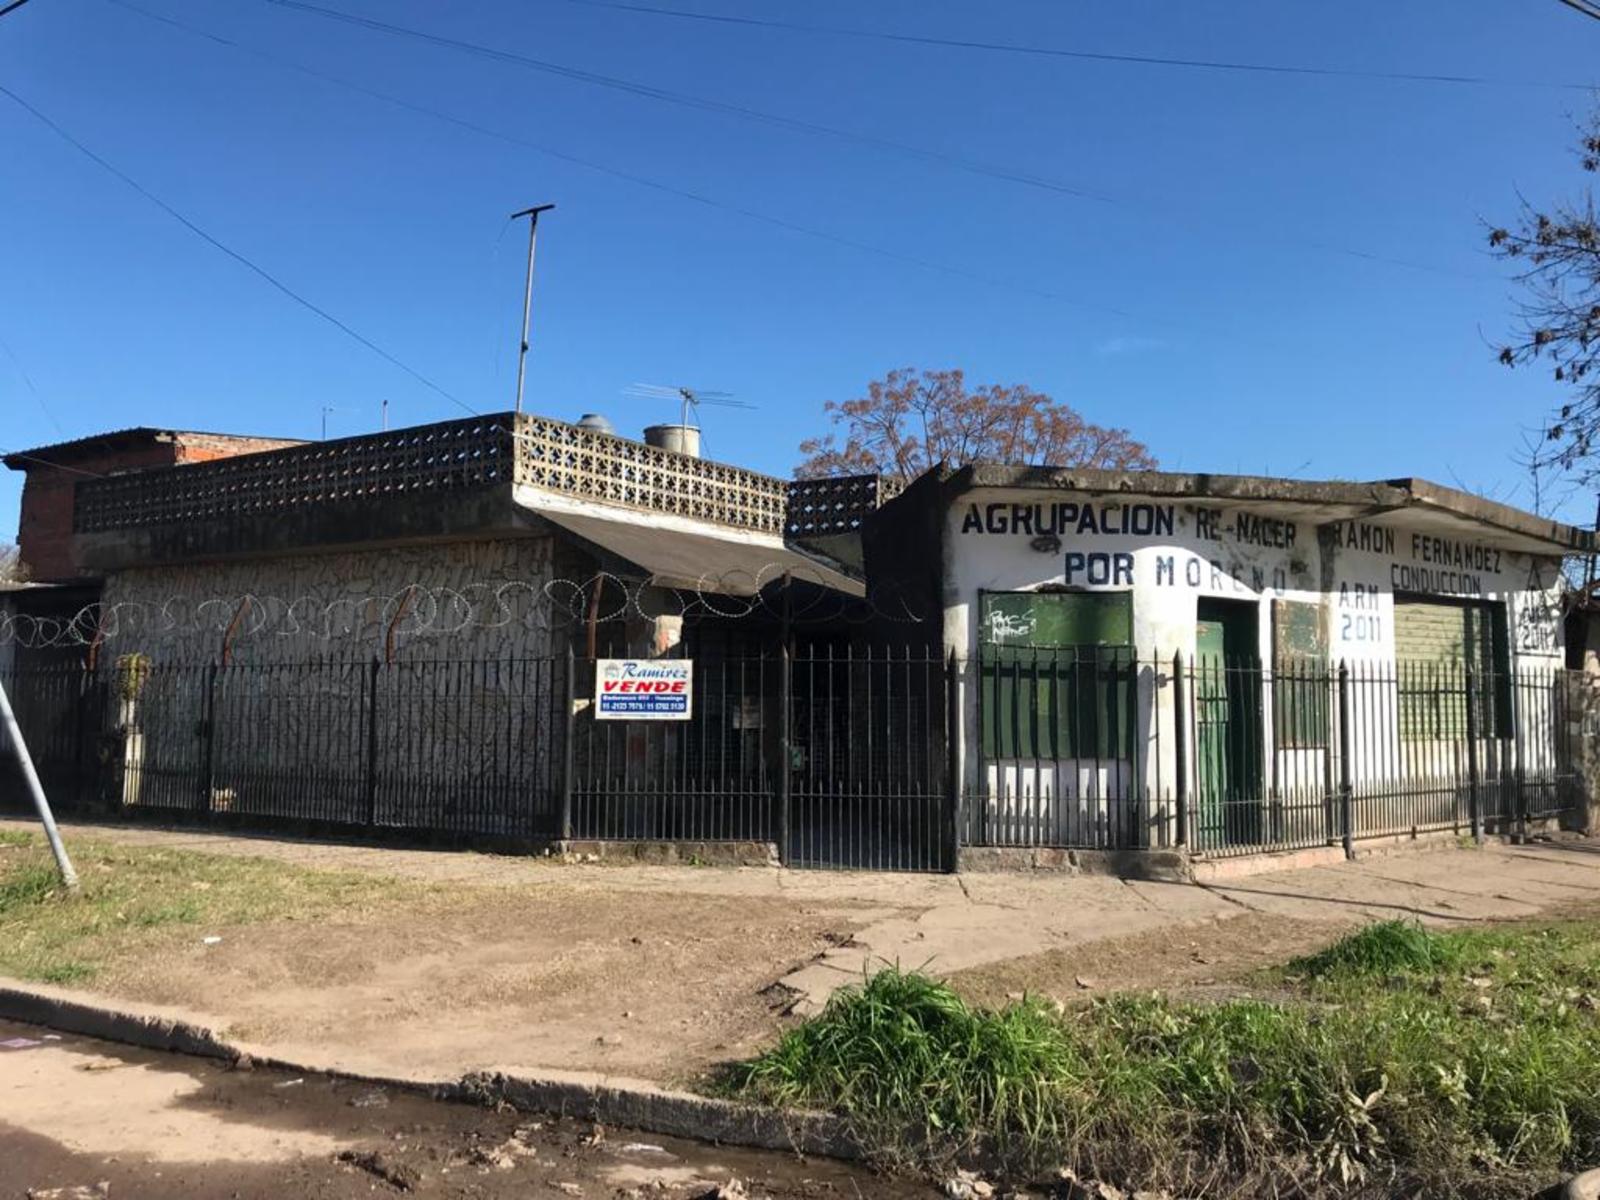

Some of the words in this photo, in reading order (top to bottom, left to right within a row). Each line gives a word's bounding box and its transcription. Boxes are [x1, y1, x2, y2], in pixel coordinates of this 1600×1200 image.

[961, 502, 1174, 536] AGRUPACION
[1334, 521, 1395, 554] RAMON
[1412, 533, 1502, 574] FERNANDEZ
[1065, 552, 1134, 585] POR
[1391, 563, 1481, 594] CONDUCCION
[1341, 615, 1381, 641] 2011
[604, 681, 687, 692] VENDE
